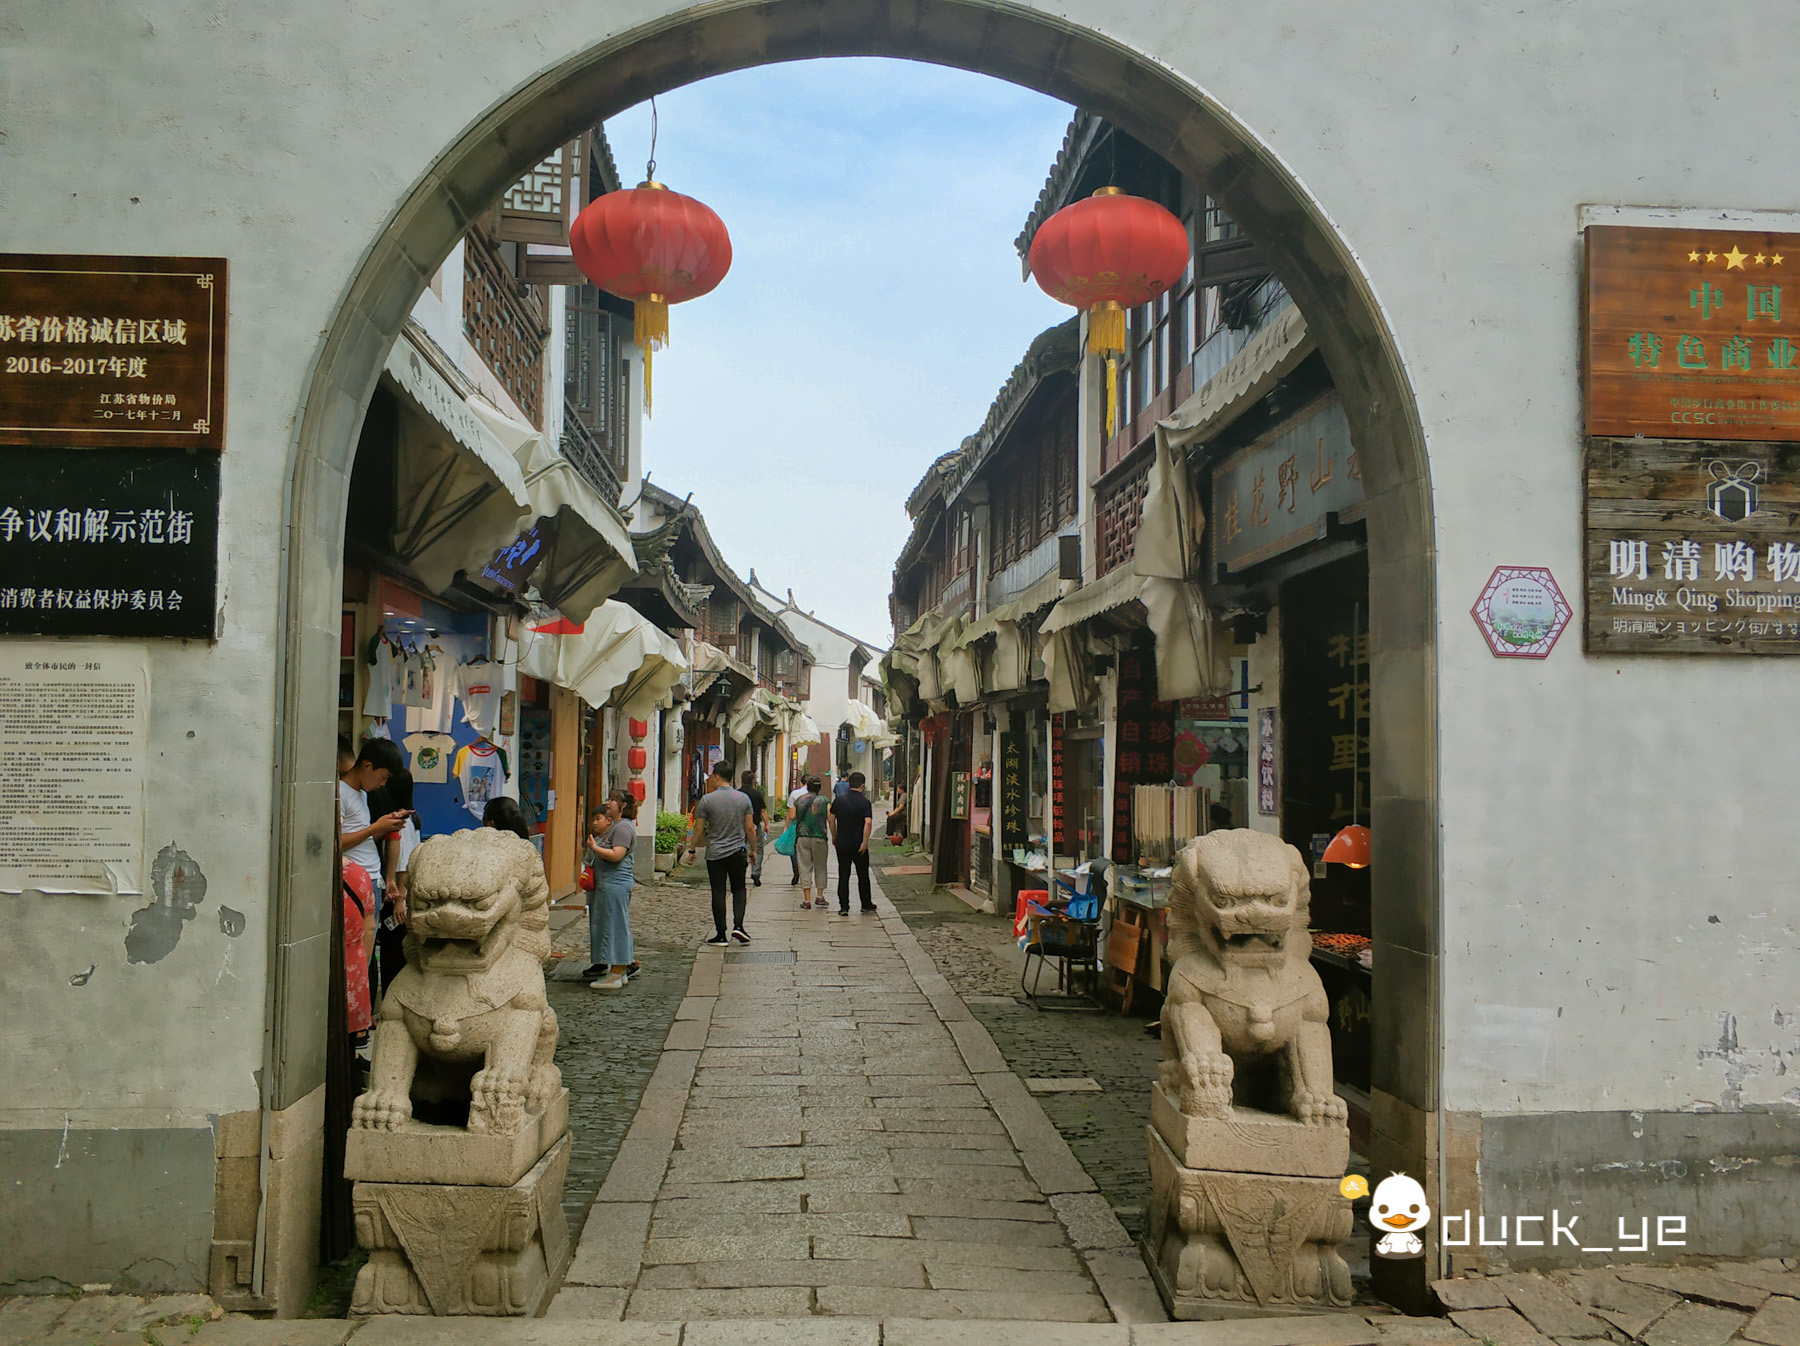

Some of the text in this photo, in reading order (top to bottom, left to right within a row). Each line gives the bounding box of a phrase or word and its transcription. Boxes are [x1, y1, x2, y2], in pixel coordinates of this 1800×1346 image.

[1690, 281, 1782, 322] 中国
[0, 315, 187, 345] 苏省价格诚信区域
[1628, 332, 1799, 371] 特色商业
[6, 356, 148, 378] 2016-2017年度
[99, 393, 177, 406] 江苏省物价局
[1671, 411, 1716, 425] CCSC
[0, 506, 195, 545] 争议和解示范街
[1609, 540, 1800, 583] 明清购物
[1, 587, 184, 611] 消费者权益保护委员会
[1611, 586, 1668, 612] Ming&
[1676, 587, 1718, 613] Qing
[25, 661, 101, 671] 致全体市民的一封信
[1117, 658, 1143, 775] 自产自销
[1004, 740, 1022, 835] 太湖淡水珍珠
